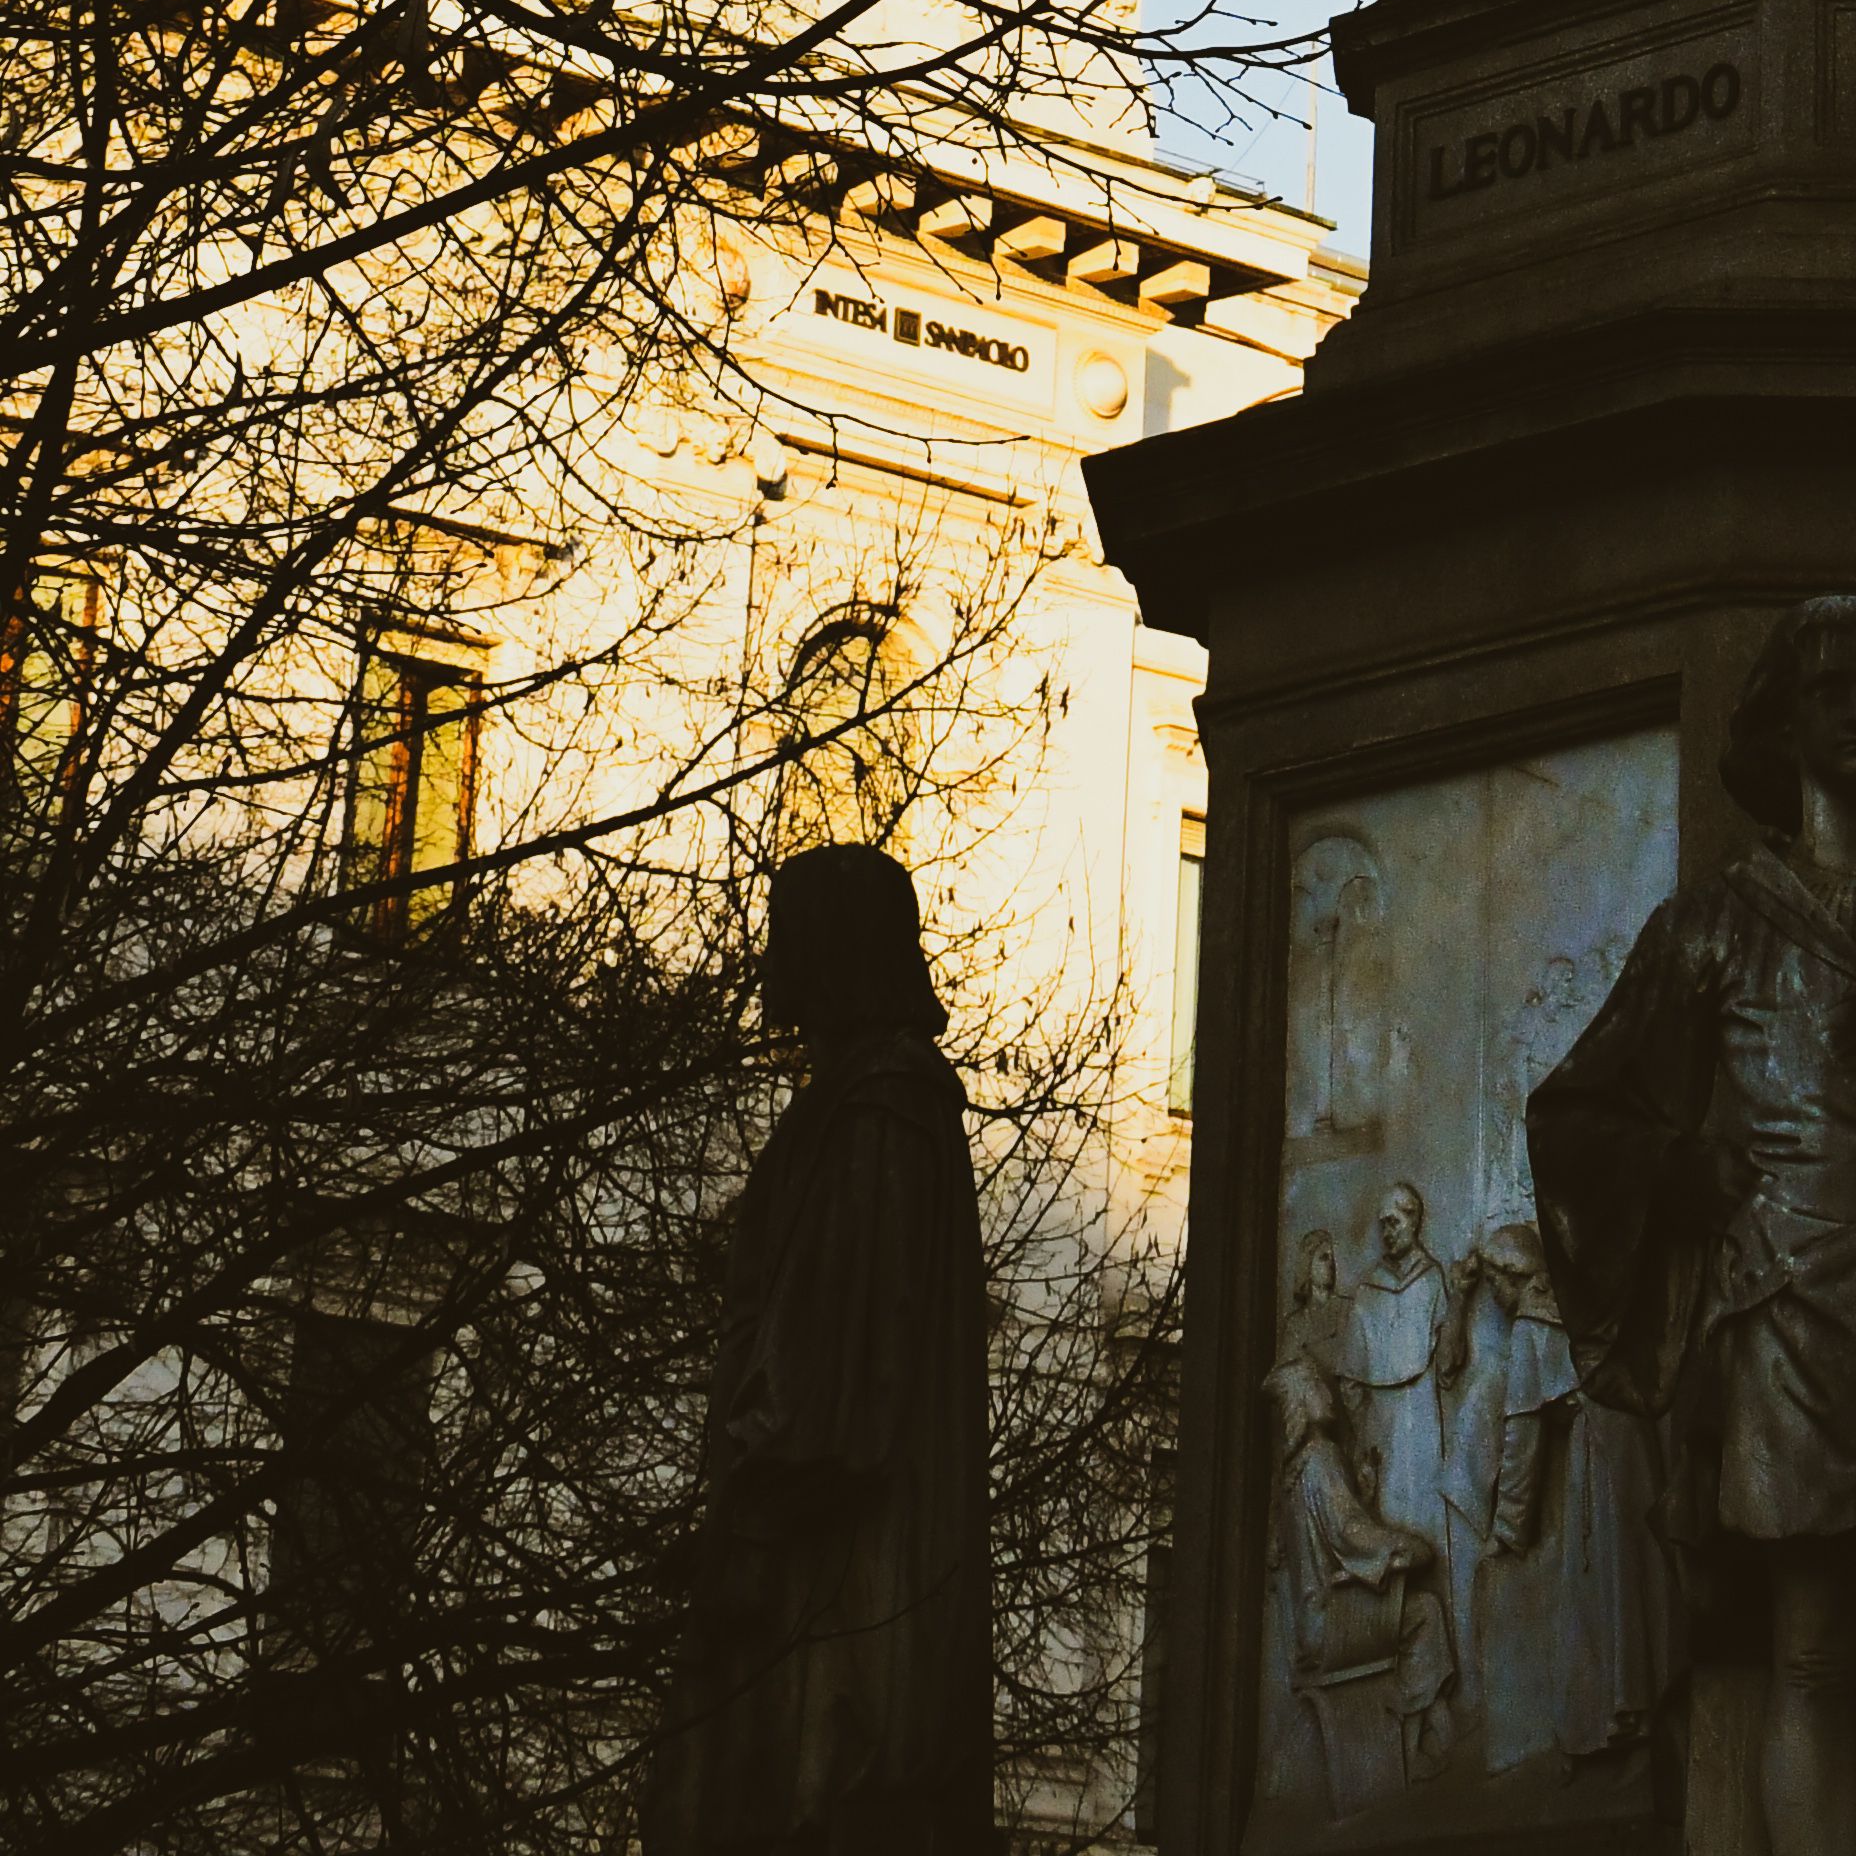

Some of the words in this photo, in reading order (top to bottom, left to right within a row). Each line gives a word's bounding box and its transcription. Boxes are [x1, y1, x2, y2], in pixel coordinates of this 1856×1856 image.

[1429, 63, 1741, 201] LEONARDO
[814, 288, 888, 333] INTESA
[924, 321, 1029, 373] SANPAOLO
